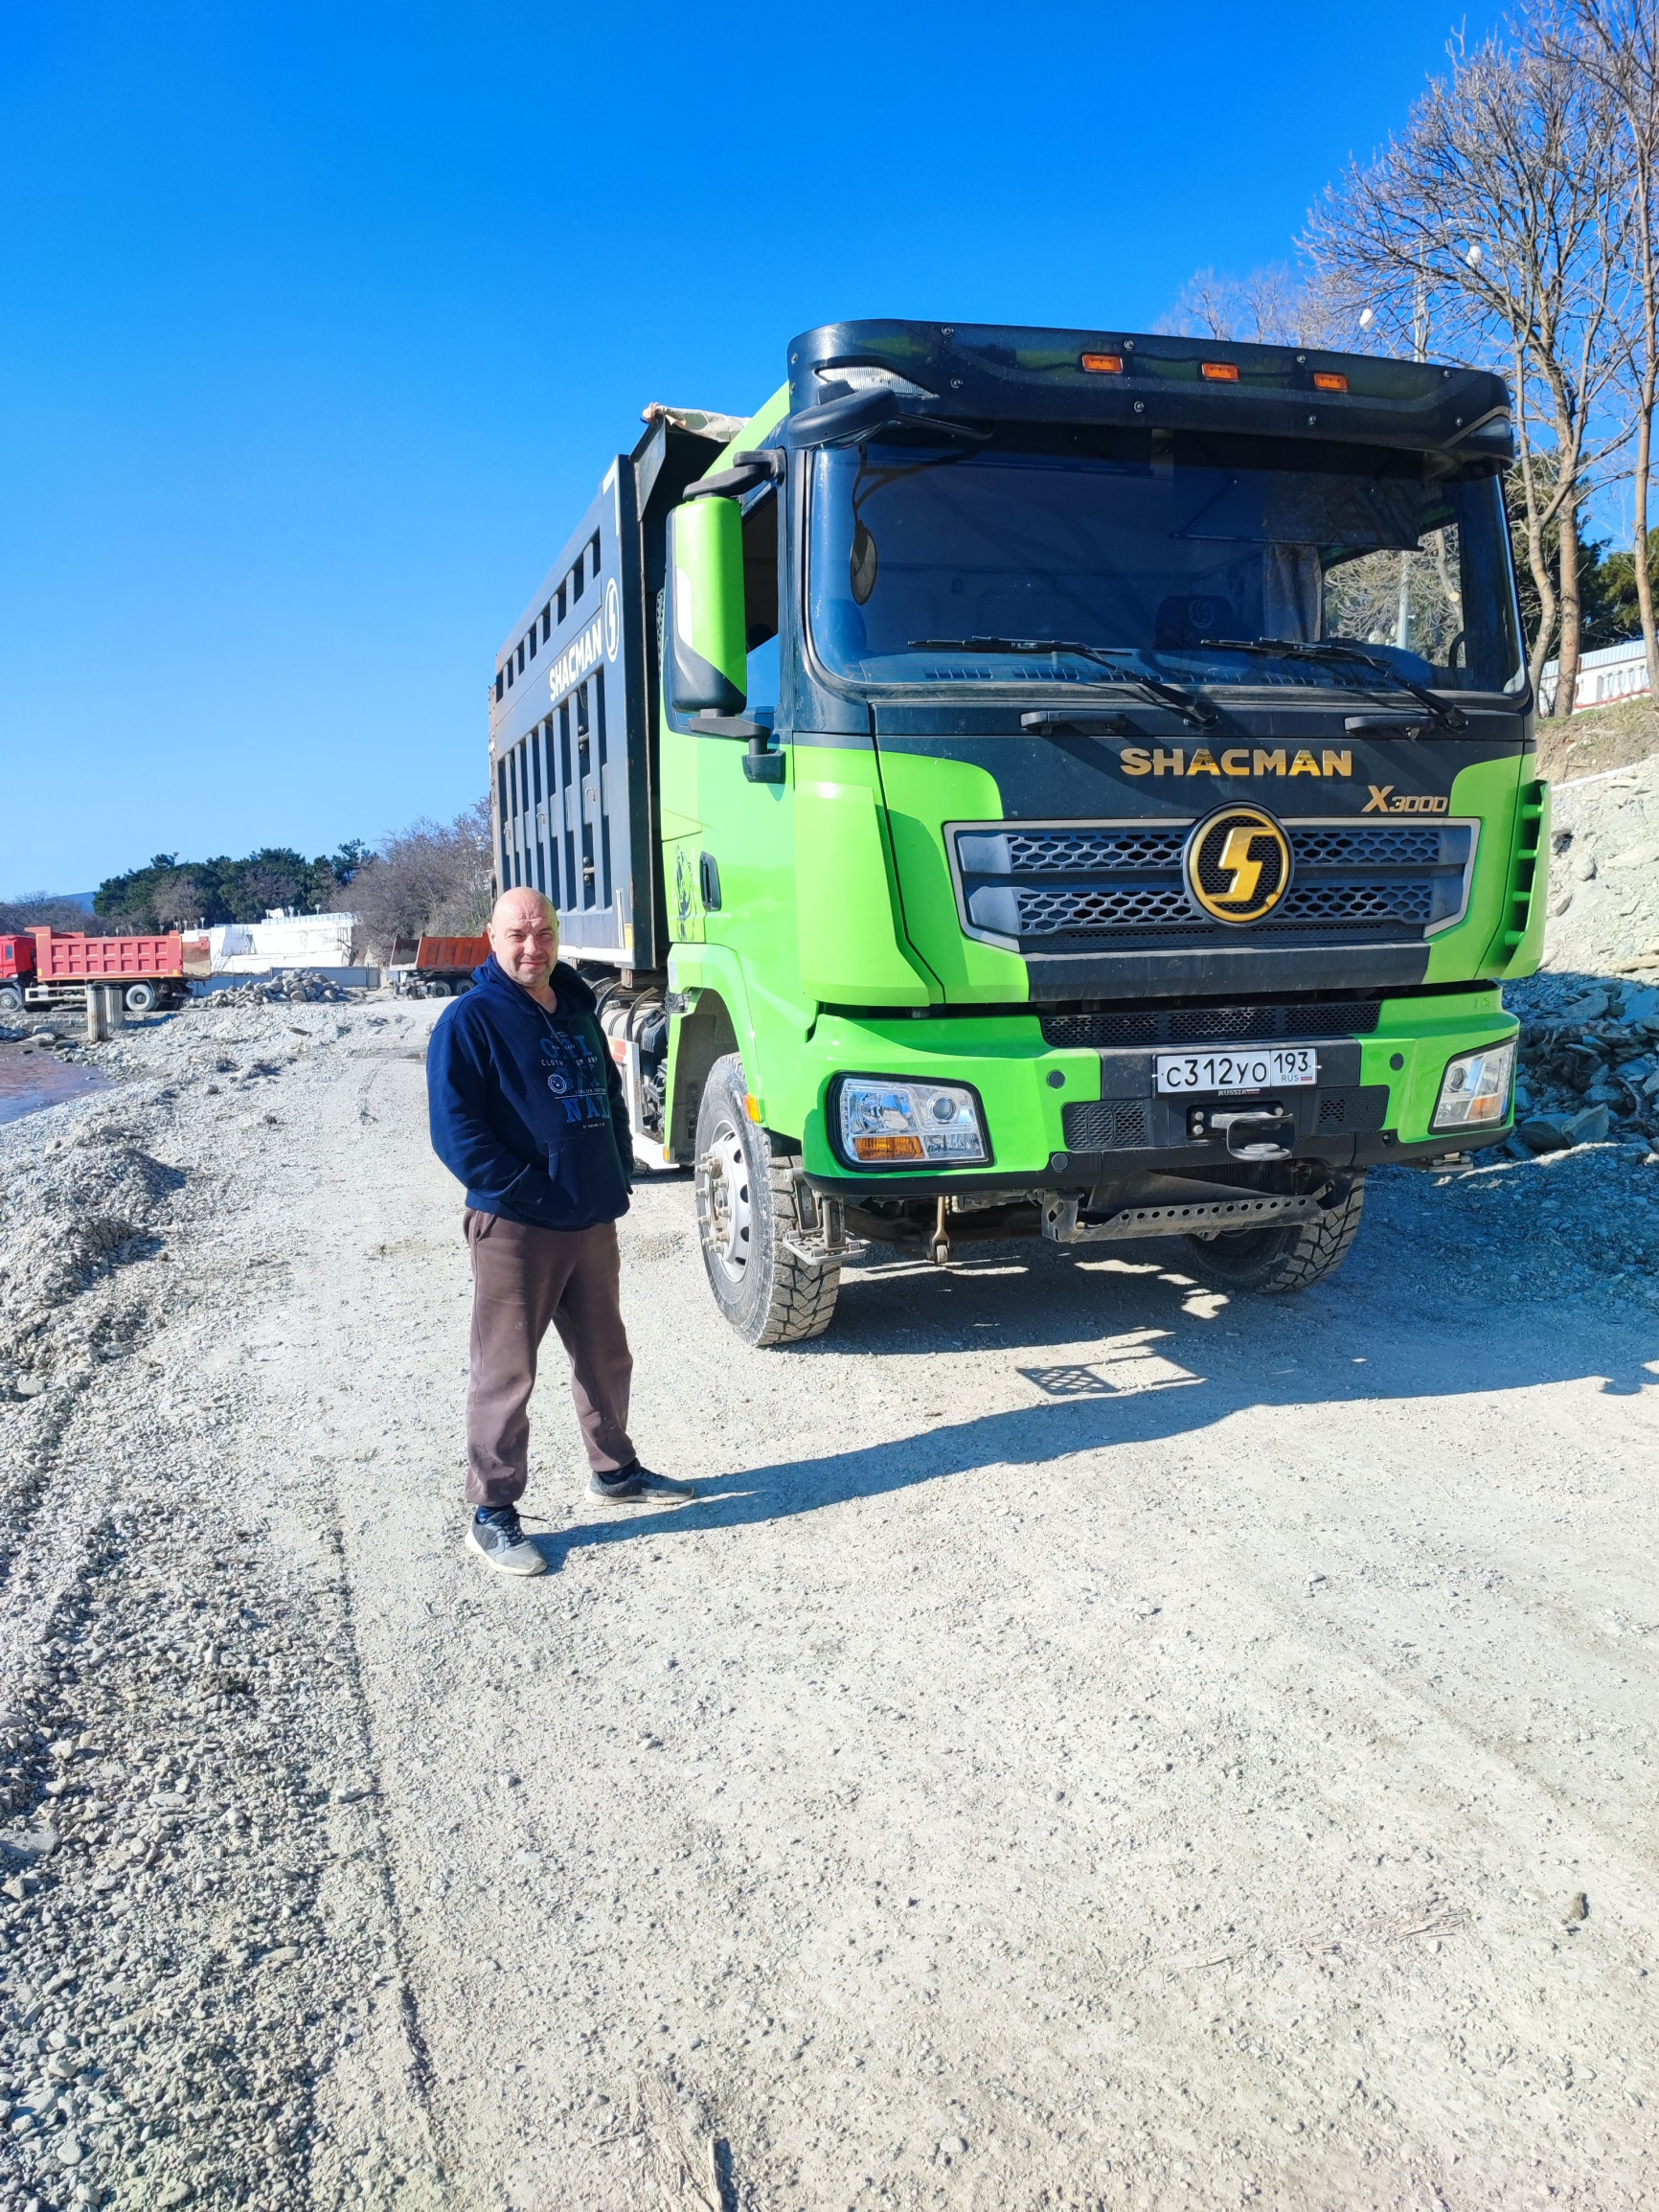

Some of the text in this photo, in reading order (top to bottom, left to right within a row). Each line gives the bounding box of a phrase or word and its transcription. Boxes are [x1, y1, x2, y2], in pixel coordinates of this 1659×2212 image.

[549, 617, 602, 702] SHACMAN
[1119, 747, 1353, 777] SHACMAN
[1361, 785, 1448, 813] X3000
[1273, 1051, 1309, 1073] 193
[1281, 1074, 1300, 1083] RUS
